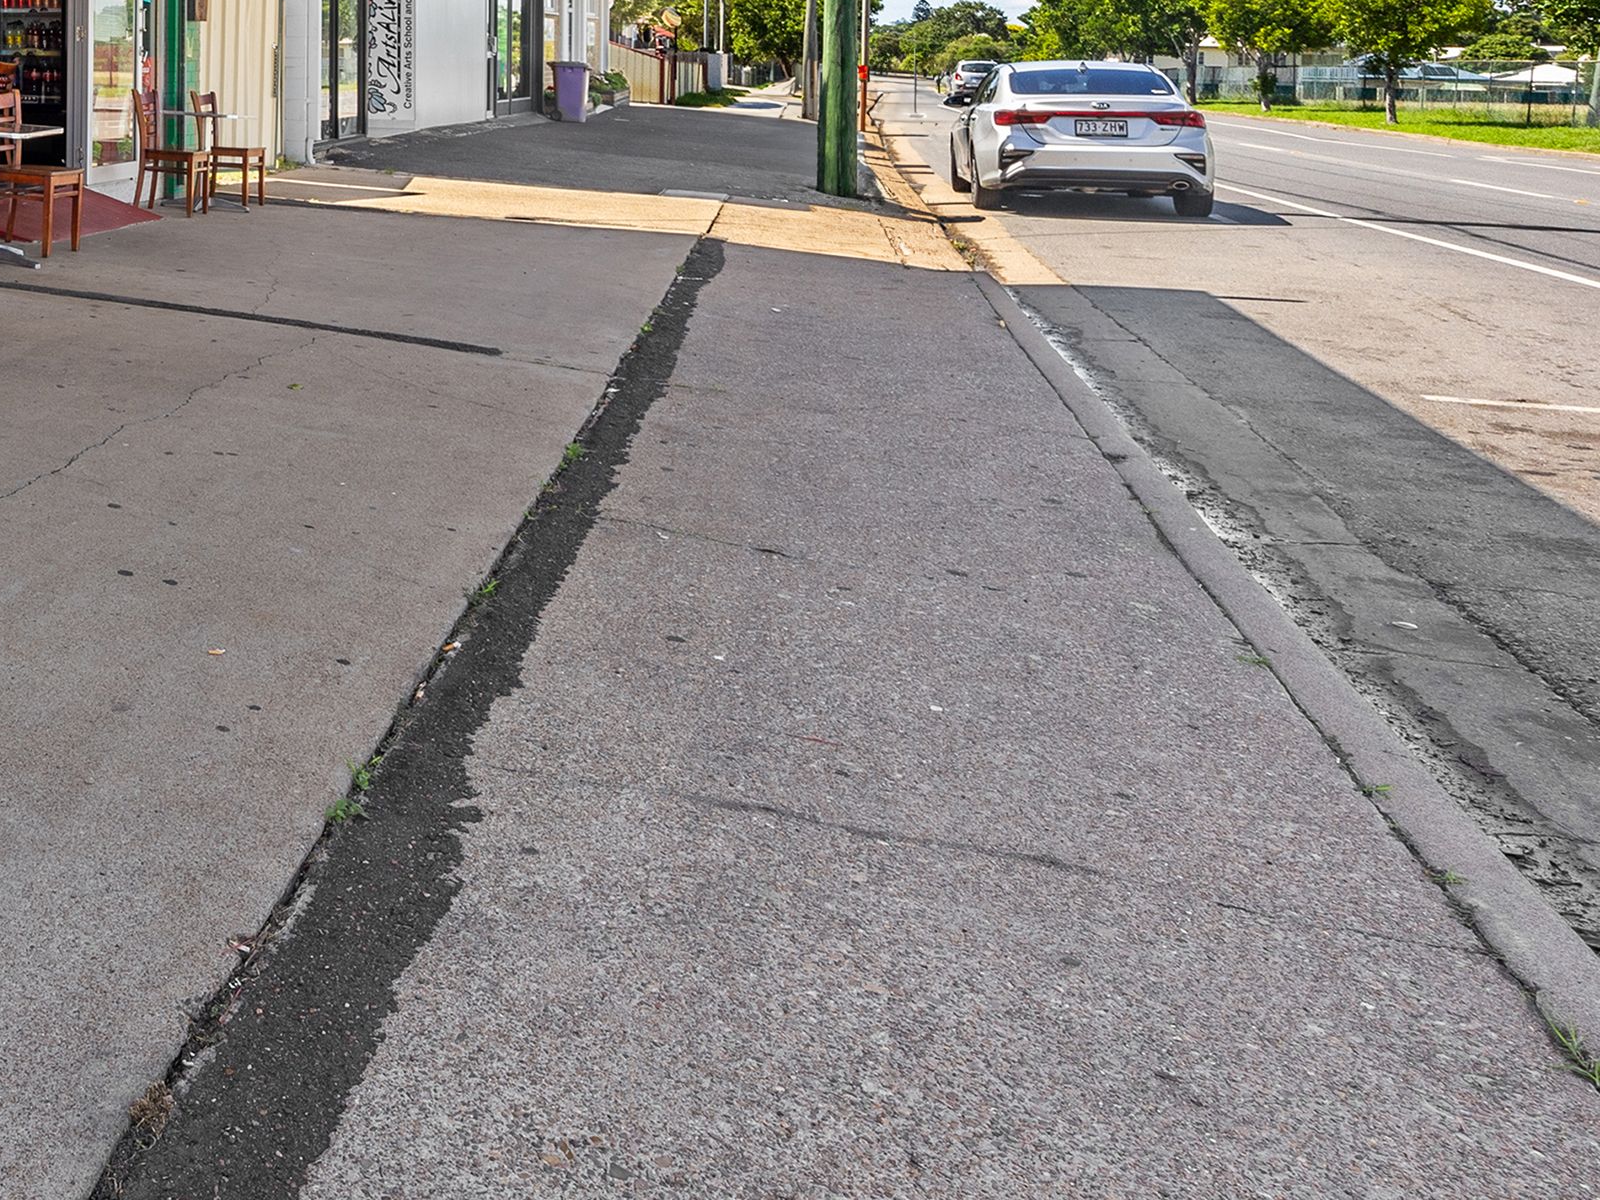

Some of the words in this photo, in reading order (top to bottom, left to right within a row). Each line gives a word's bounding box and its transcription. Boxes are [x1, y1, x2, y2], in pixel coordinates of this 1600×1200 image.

[403, 16, 413, 49] School
[403, 51, 413, 70] Arts
[403, 71, 413, 109] Creative
